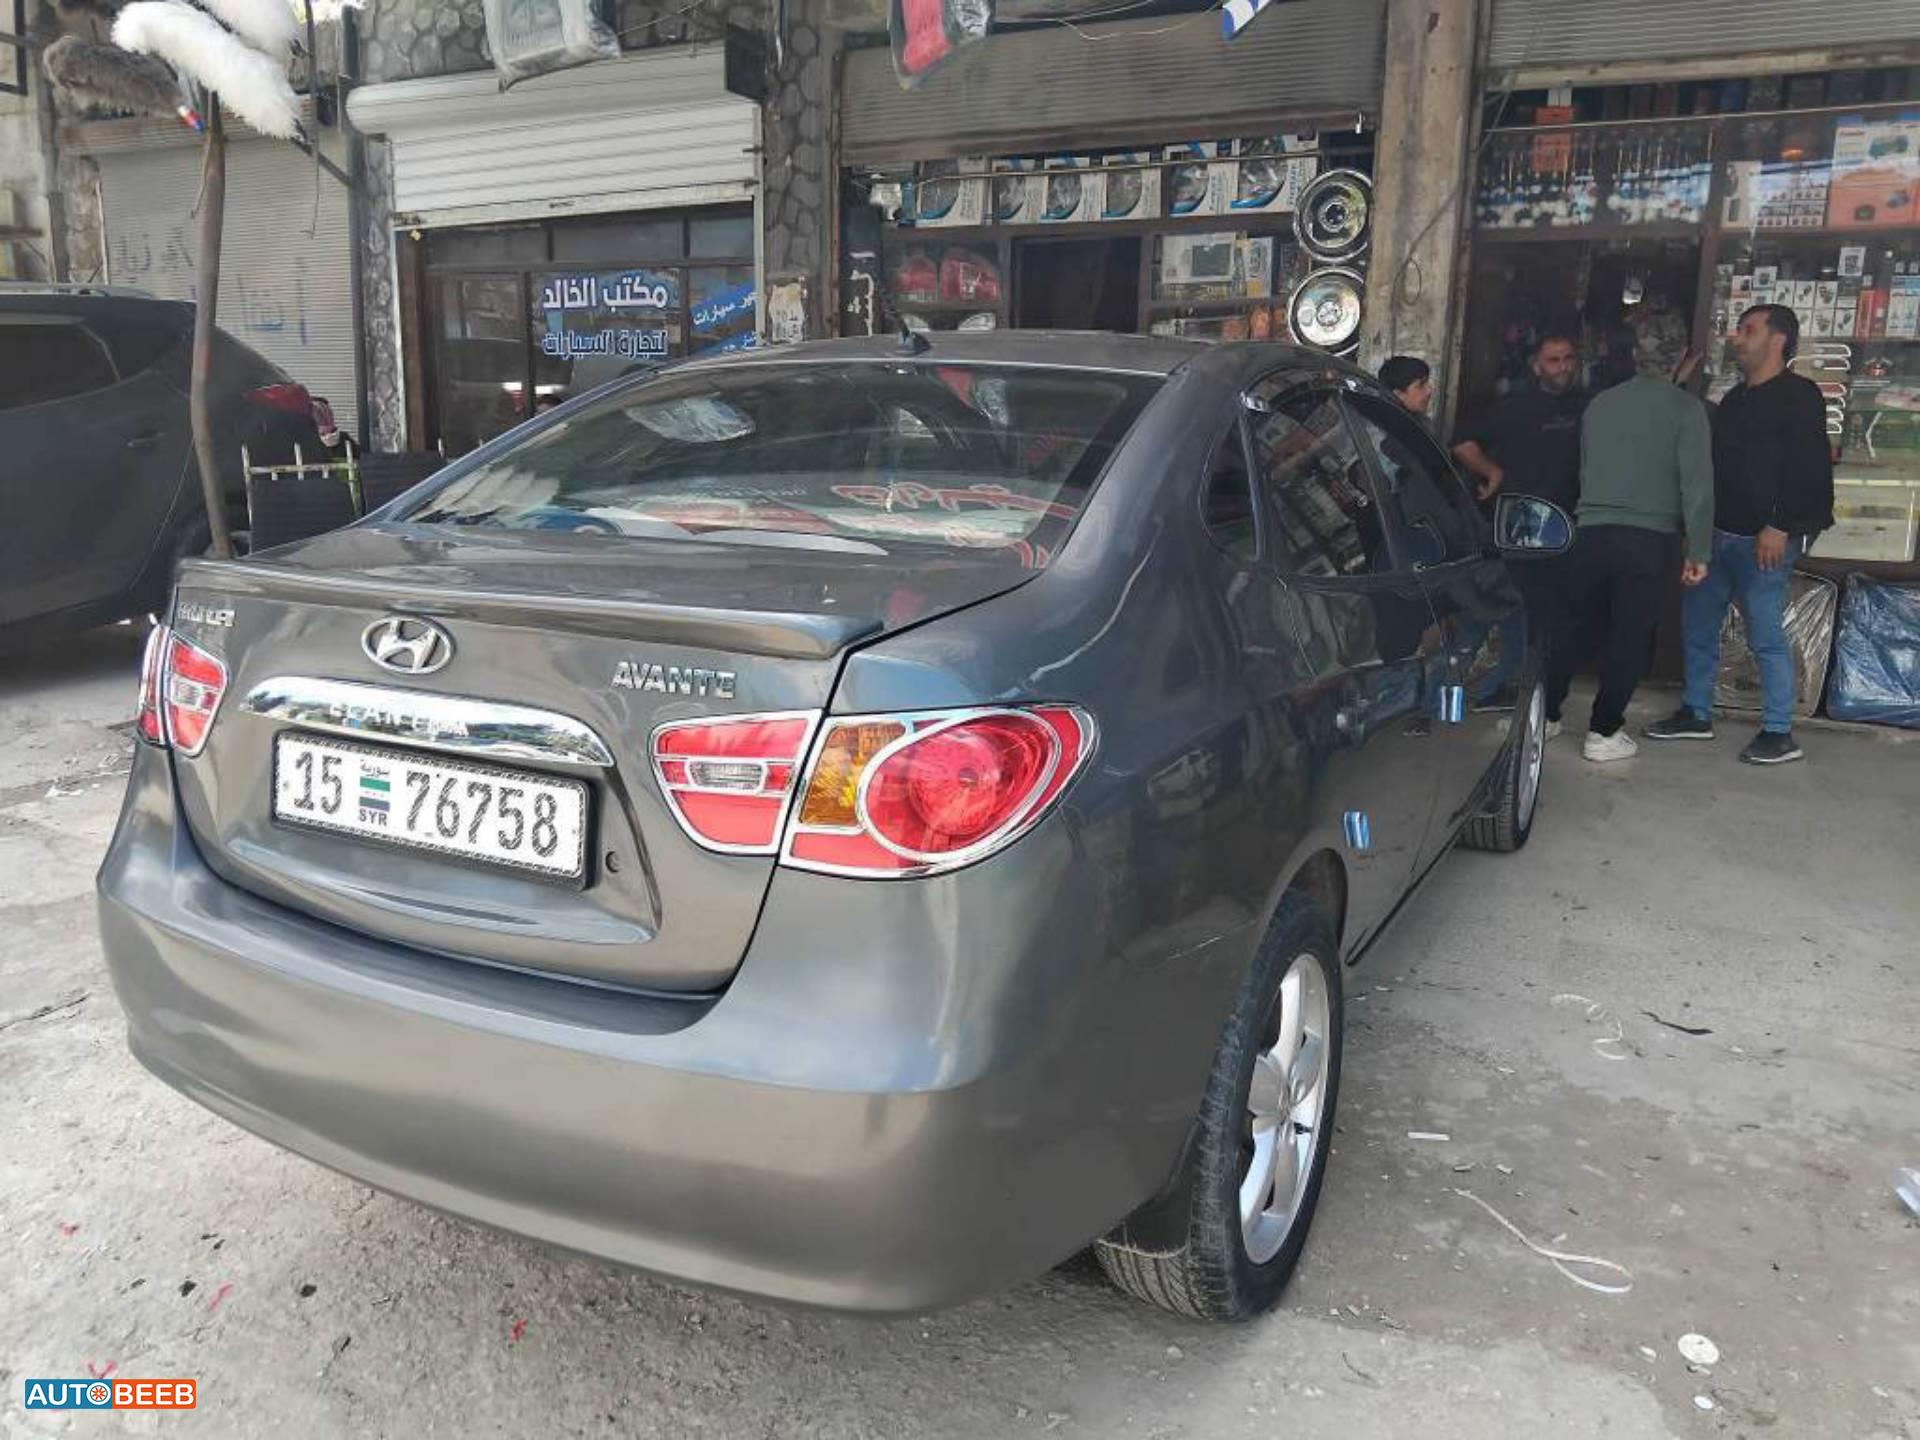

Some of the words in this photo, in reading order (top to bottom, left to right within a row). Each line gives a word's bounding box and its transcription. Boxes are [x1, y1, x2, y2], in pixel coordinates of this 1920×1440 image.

[543, 277, 597, 309] الخالد
[603, 275, 669, 313] مكتب
[543, 329, 614, 360] السيارات
[618, 329, 669, 360] لتجارة
[611, 660, 737, 700] AVANTE
[293, 751, 343, 815] 15
[359, 807, 388, 827] SYR
[405, 770, 559, 859] 76758
